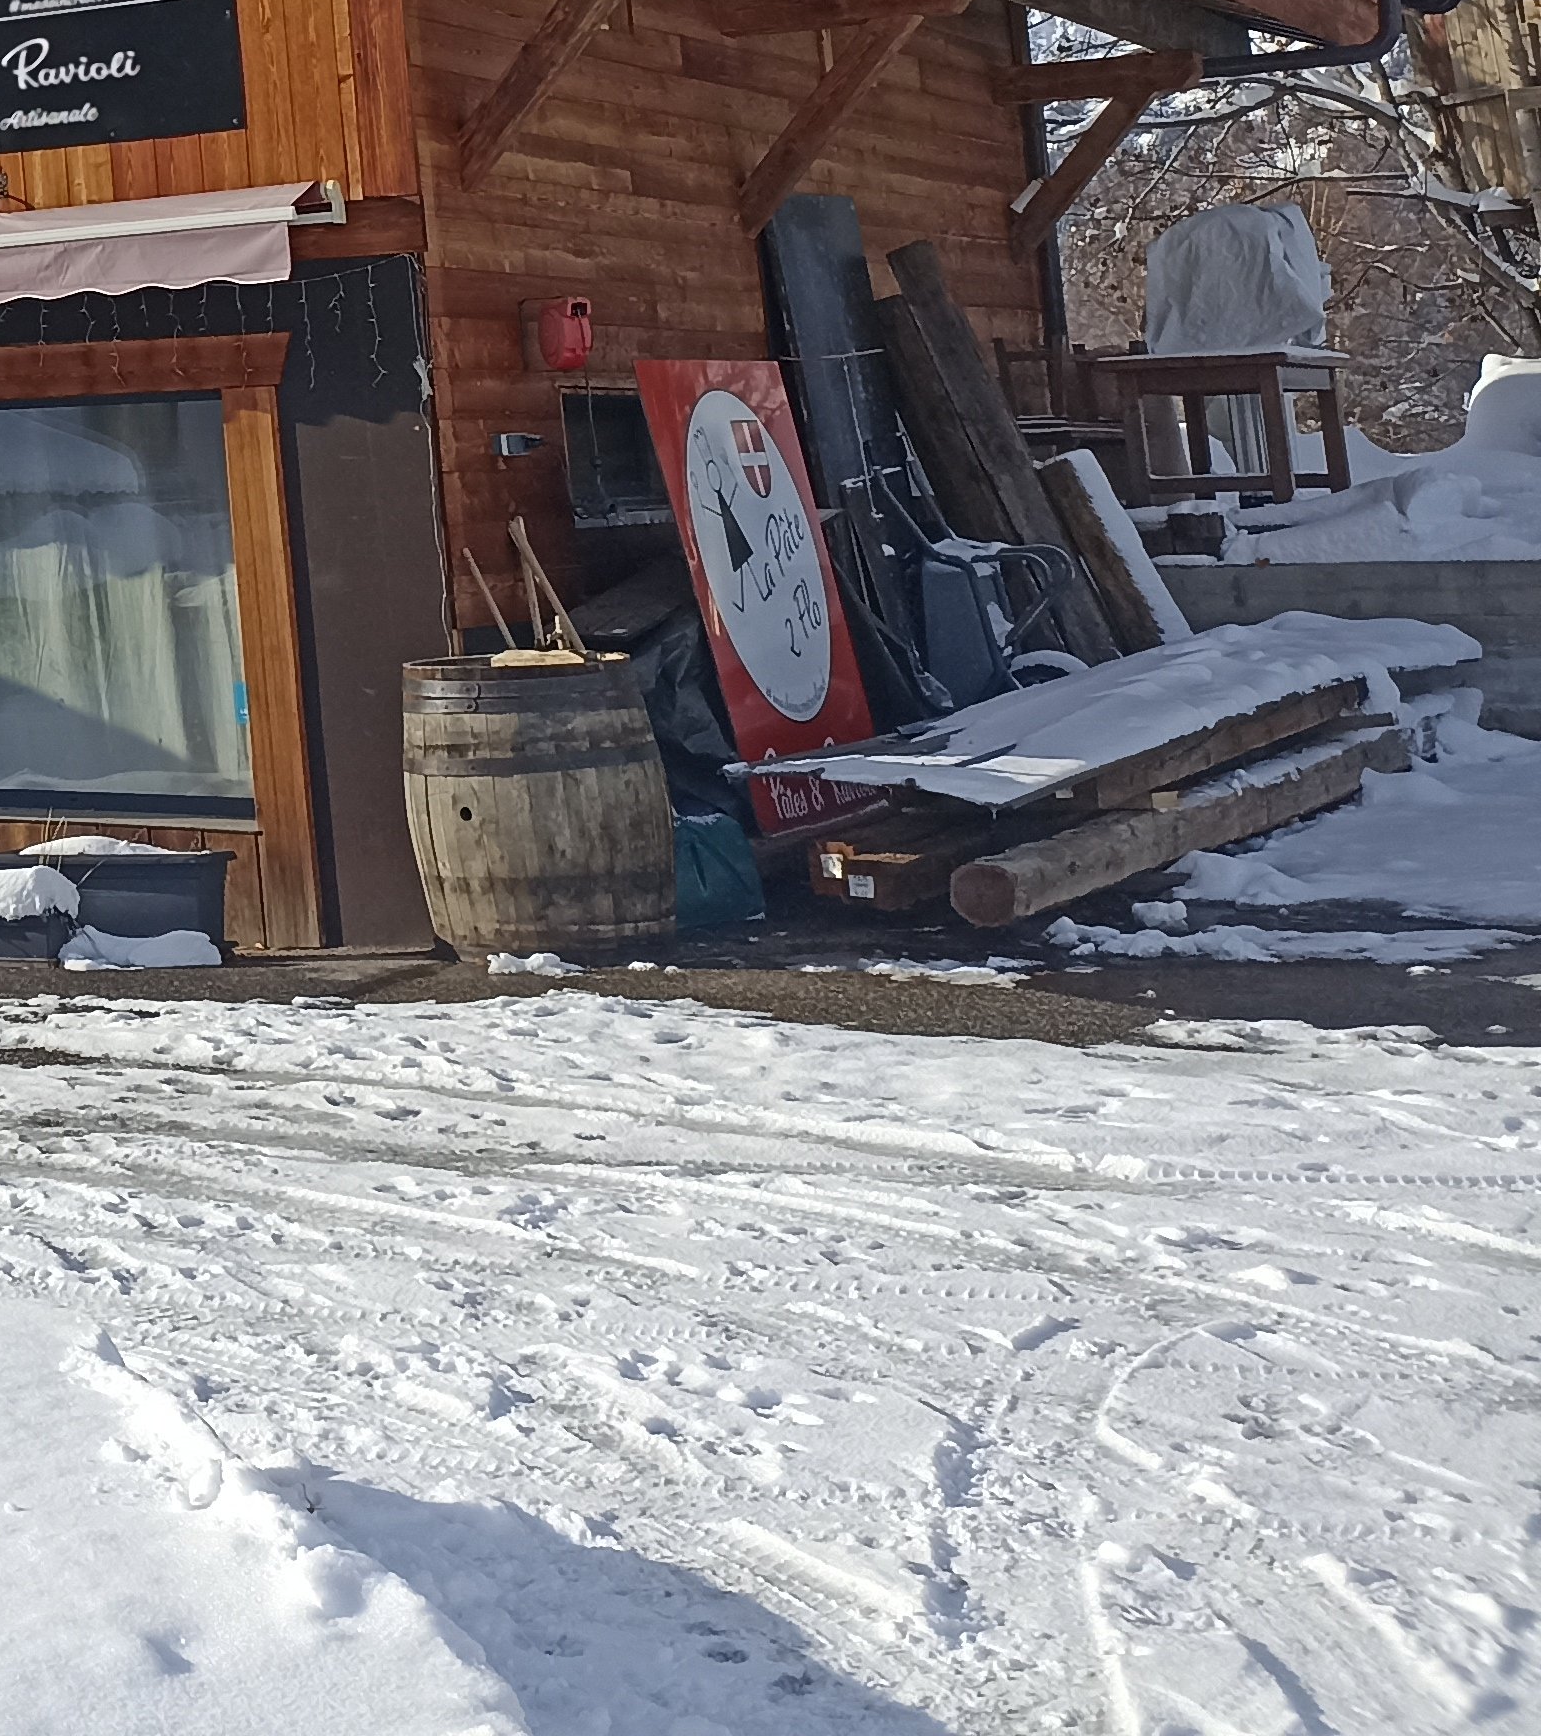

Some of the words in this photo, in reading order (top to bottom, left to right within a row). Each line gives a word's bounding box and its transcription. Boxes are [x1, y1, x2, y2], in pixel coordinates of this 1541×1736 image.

[1, 37, 141, 90] Ravioli
[0, 102, 100, 132] Artisanale
[765, 507, 805, 578] Pâte
[793, 578, 822, 640] Flo
[785, 617, 802, 658] 2
